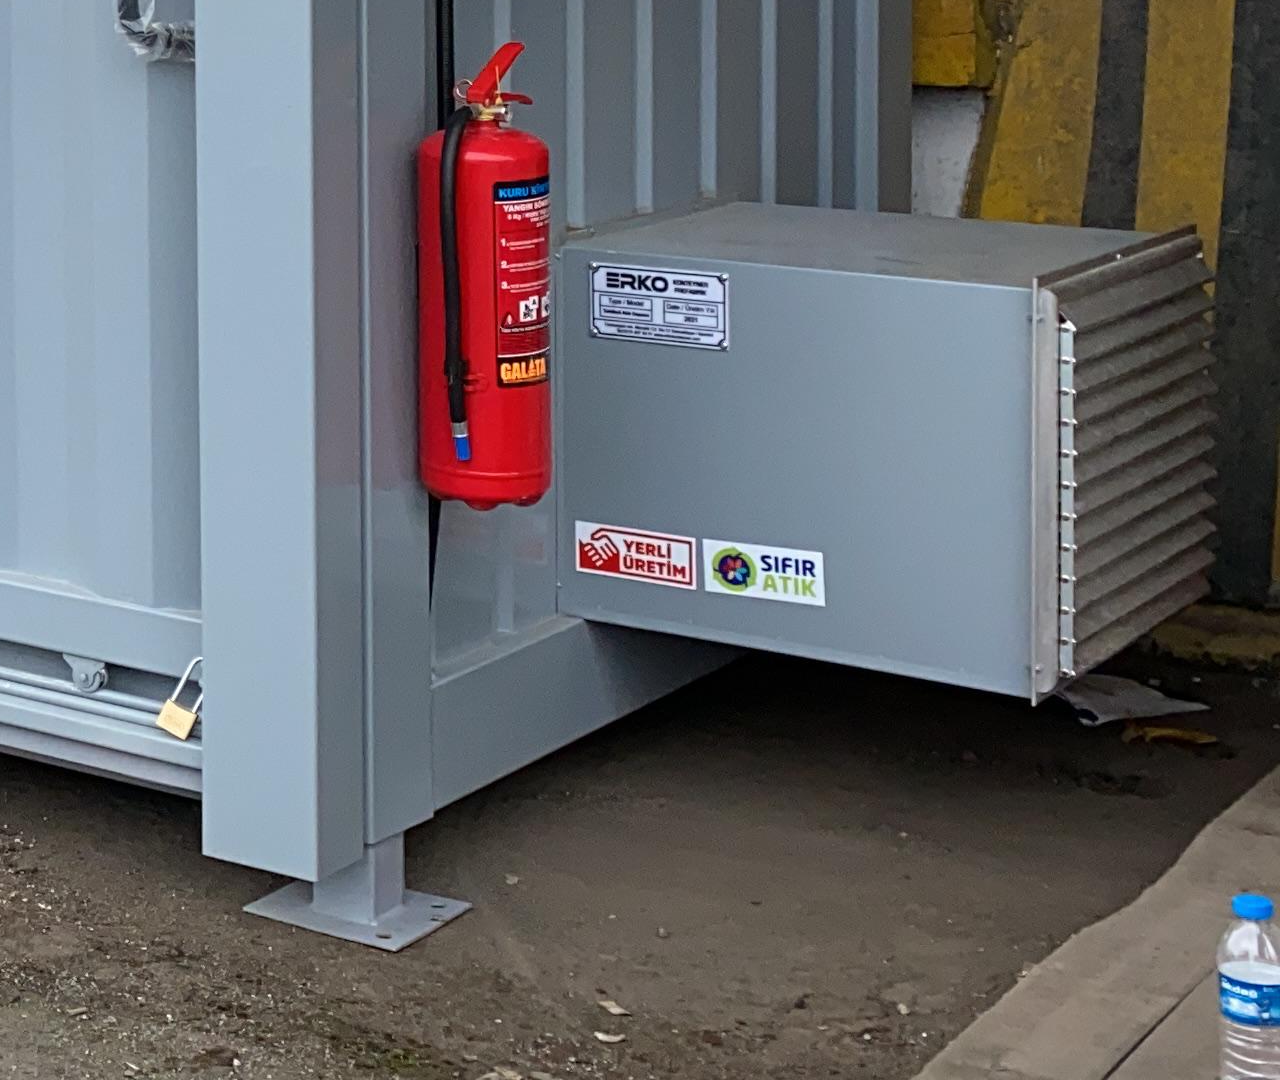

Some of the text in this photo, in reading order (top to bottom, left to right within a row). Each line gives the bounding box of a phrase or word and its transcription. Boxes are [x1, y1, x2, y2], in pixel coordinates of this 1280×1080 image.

[498, 186, 529, 198] KURU
[503, 202, 533, 213] YANGIN
[606, 272, 669, 293] ERKO
[500, 357, 546, 381] GALATA
[623, 539, 672, 559] YERLİ
[623, 554, 687, 579] ÜRETİM
[760, 554, 816, 578] SIFIR
[762, 574, 817, 598] ATIK
